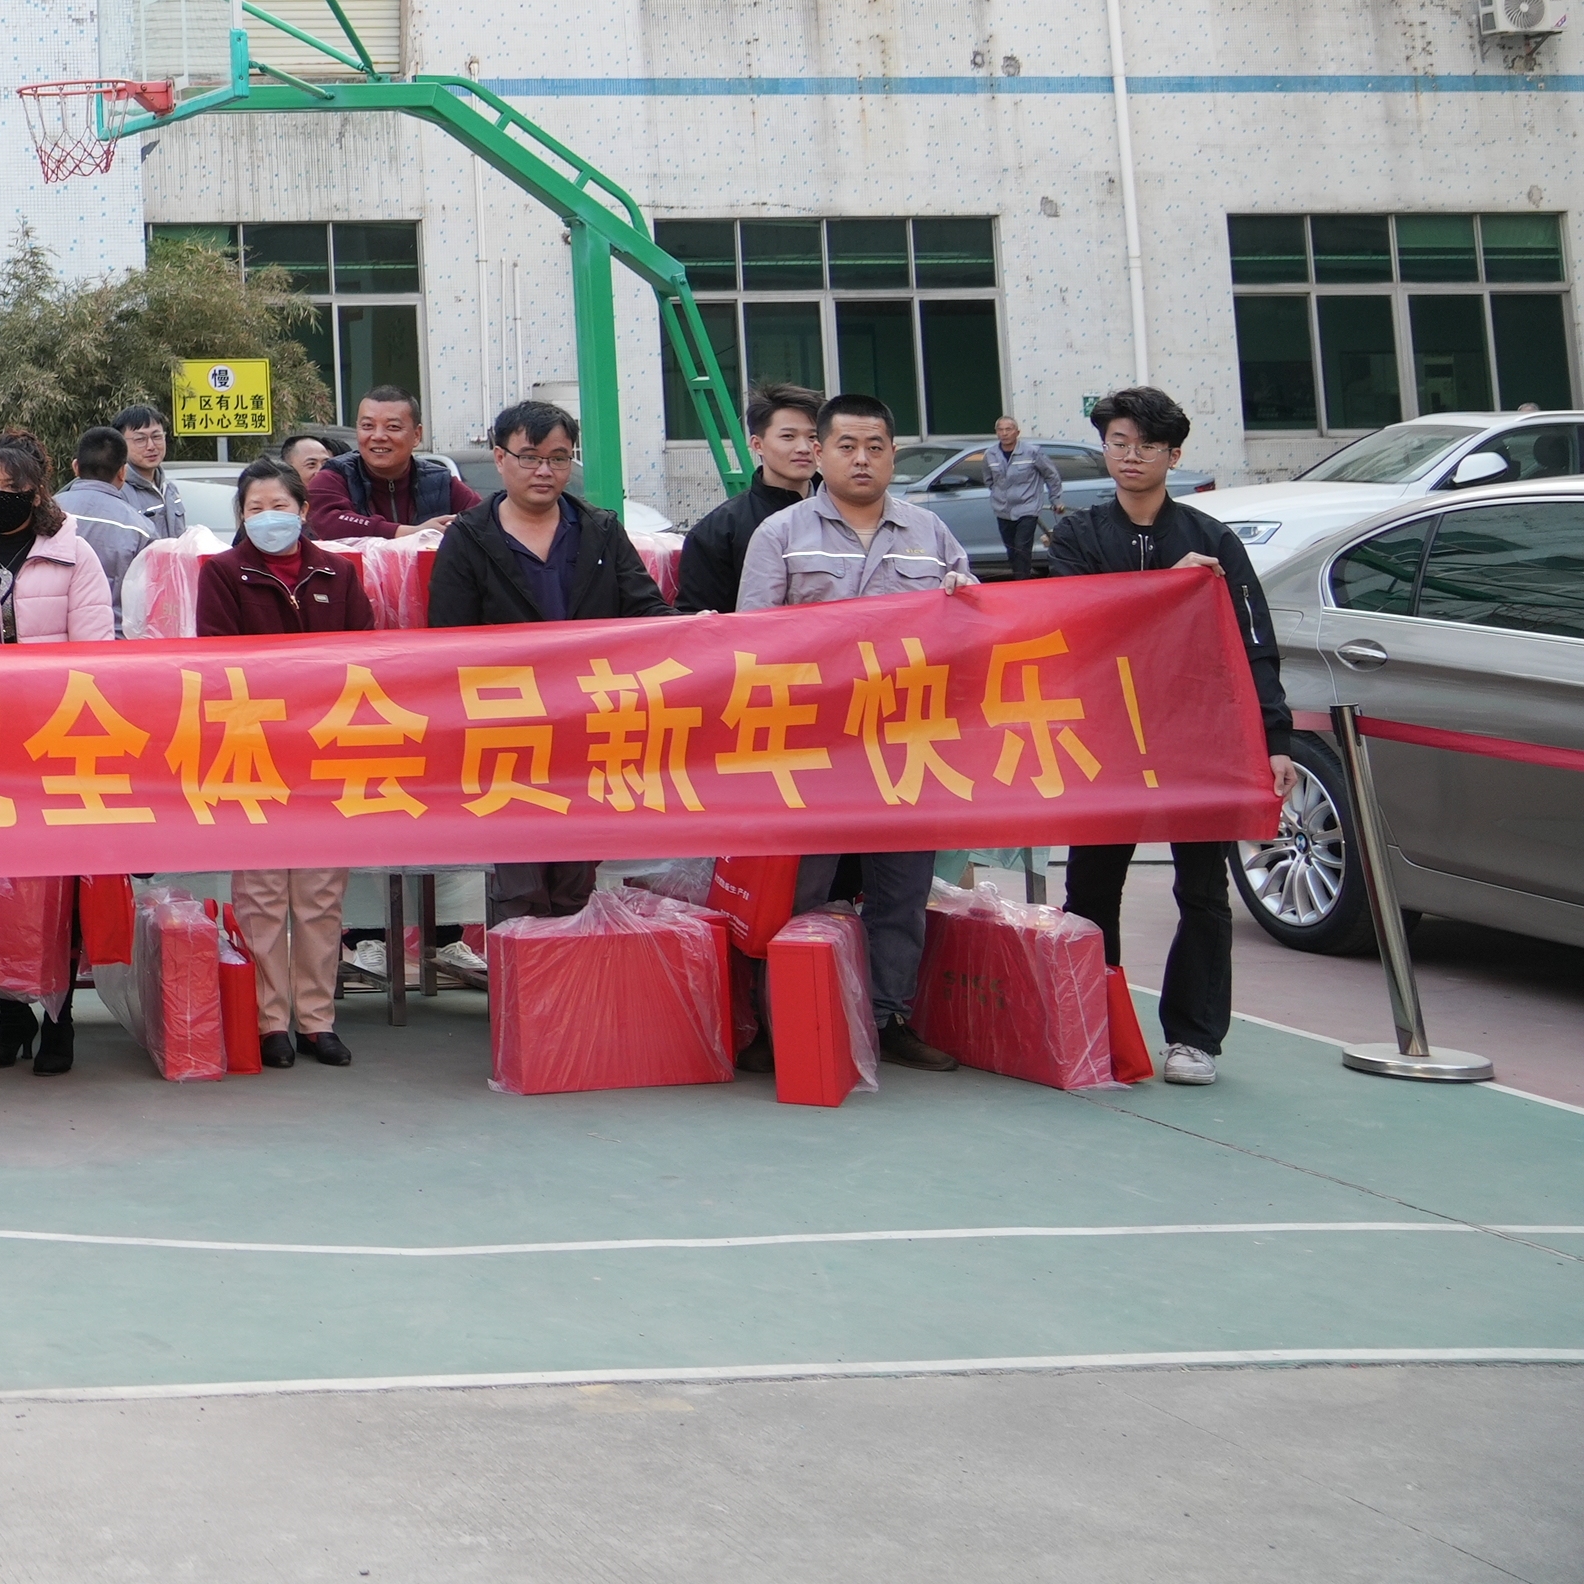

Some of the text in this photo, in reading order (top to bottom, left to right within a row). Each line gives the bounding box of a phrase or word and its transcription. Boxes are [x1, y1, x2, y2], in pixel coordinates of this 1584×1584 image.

[211, 368, 230, 388] 慢
[181, 394, 265, 411] 厂区有儿童
[181, 412, 266, 430] 请小心驾驶
